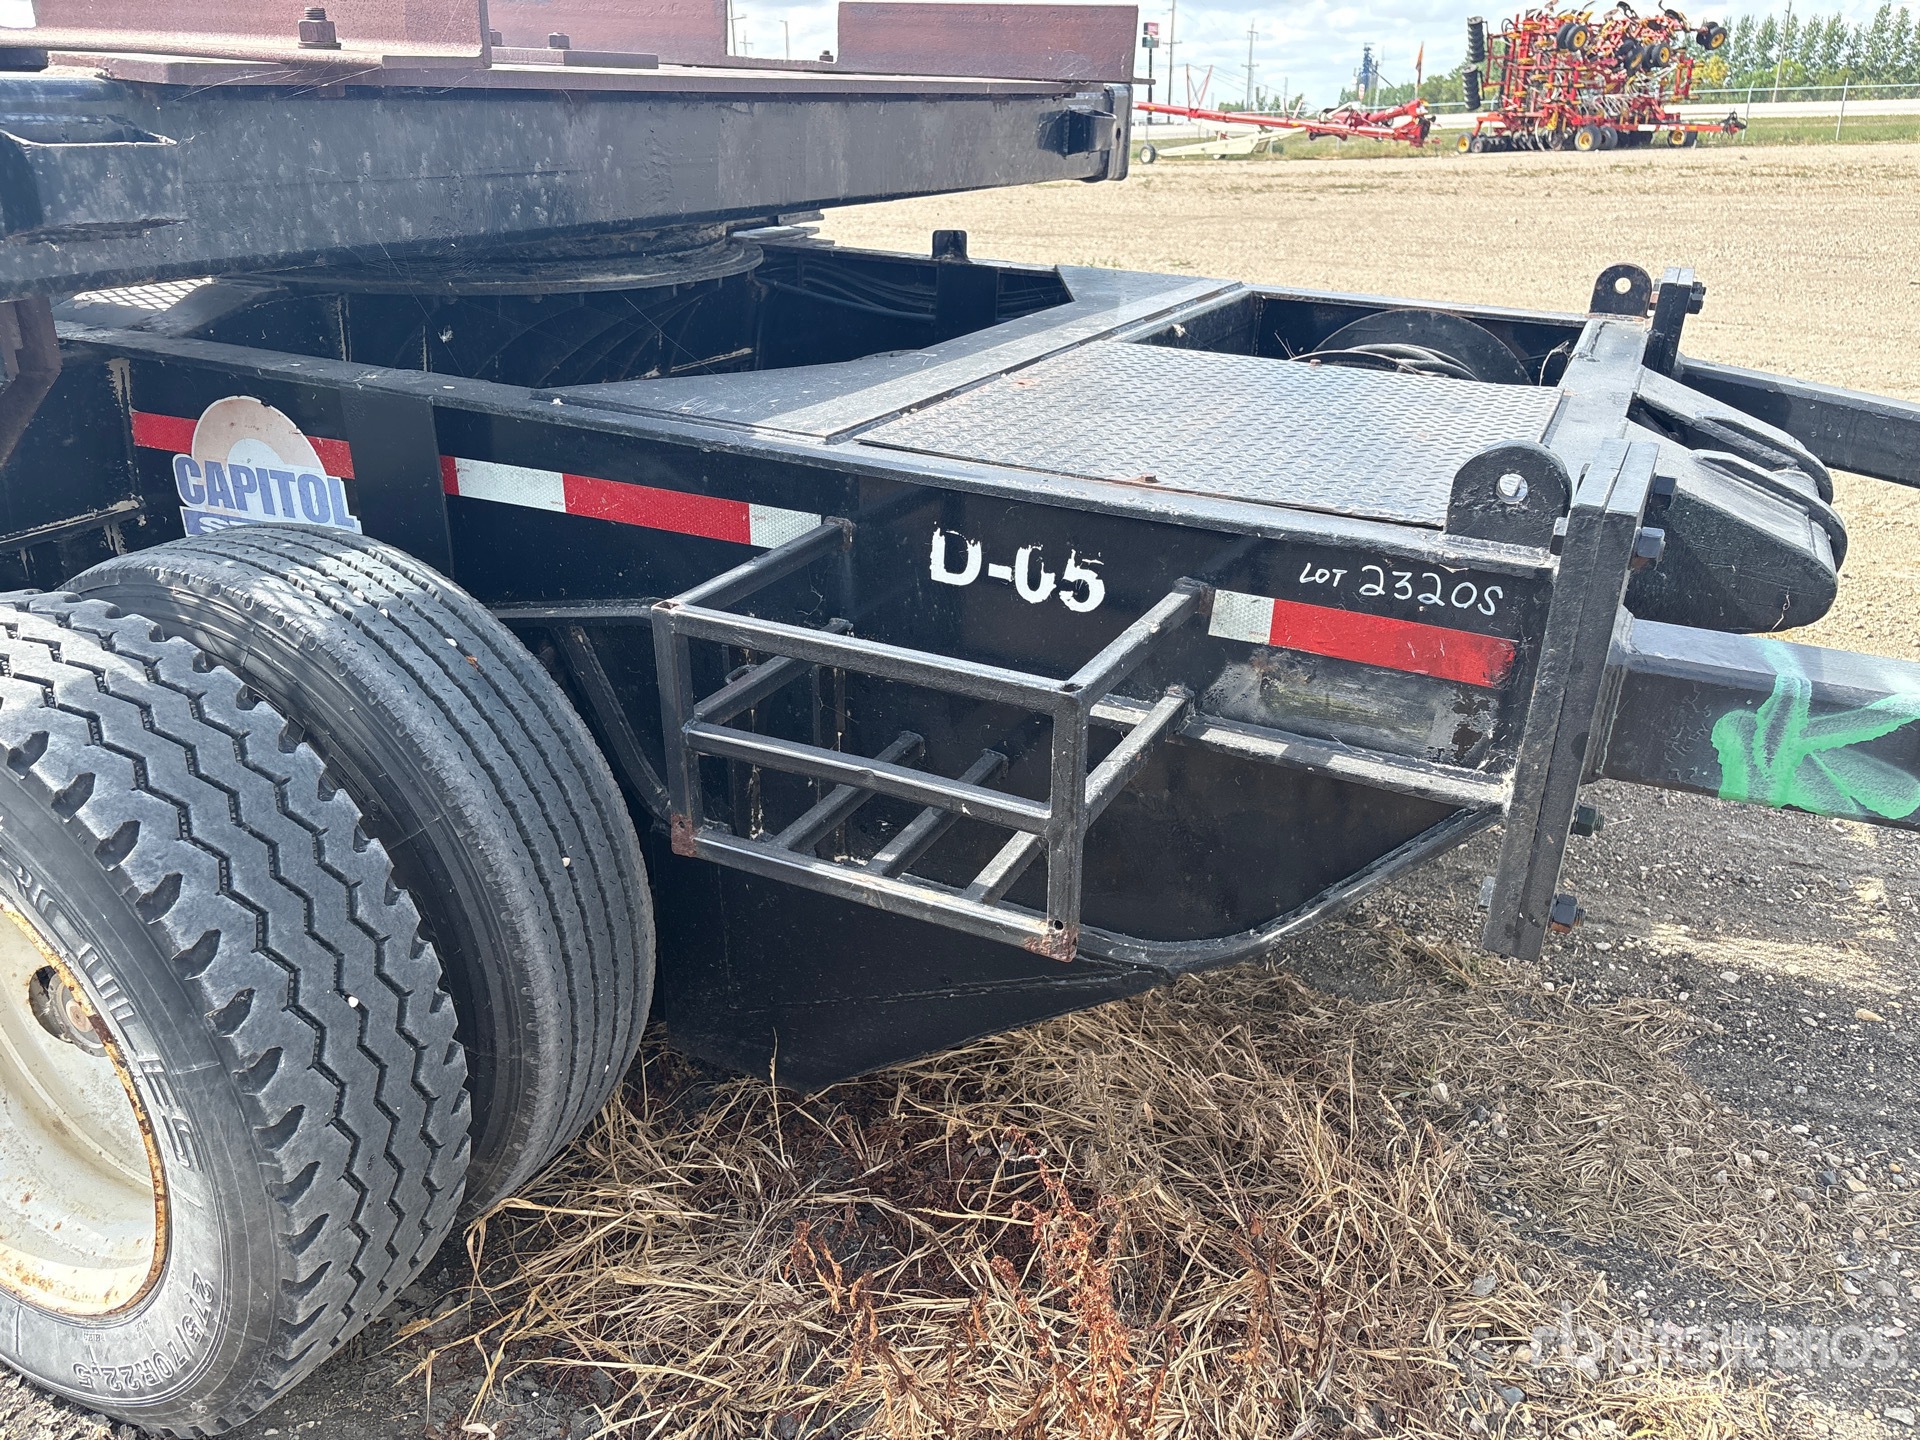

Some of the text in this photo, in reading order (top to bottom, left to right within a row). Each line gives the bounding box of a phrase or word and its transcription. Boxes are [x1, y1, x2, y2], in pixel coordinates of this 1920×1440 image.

[176, 456, 357, 528] CAPITOL
[929, 526, 1106, 613] D-05
[1299, 562, 1348, 588] LOT
[72, 1268, 215, 1392] 275/70R22.5
